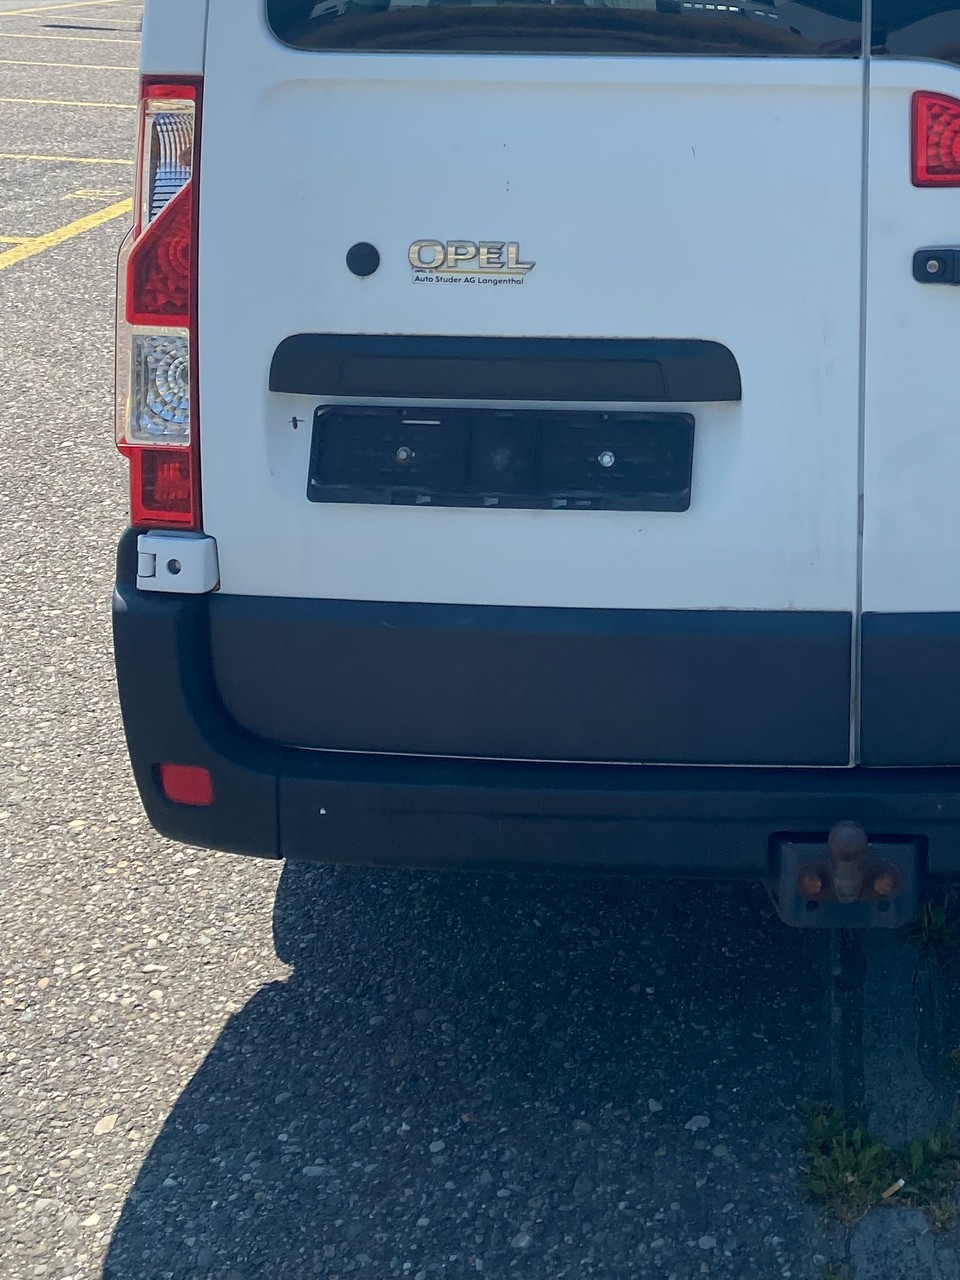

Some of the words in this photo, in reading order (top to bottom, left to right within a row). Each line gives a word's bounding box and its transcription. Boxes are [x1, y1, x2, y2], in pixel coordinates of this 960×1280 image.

[408, 239, 536, 270] OPEL
[414, 275, 434, 283] Auto
[477, 277, 524, 286] Langenthal
